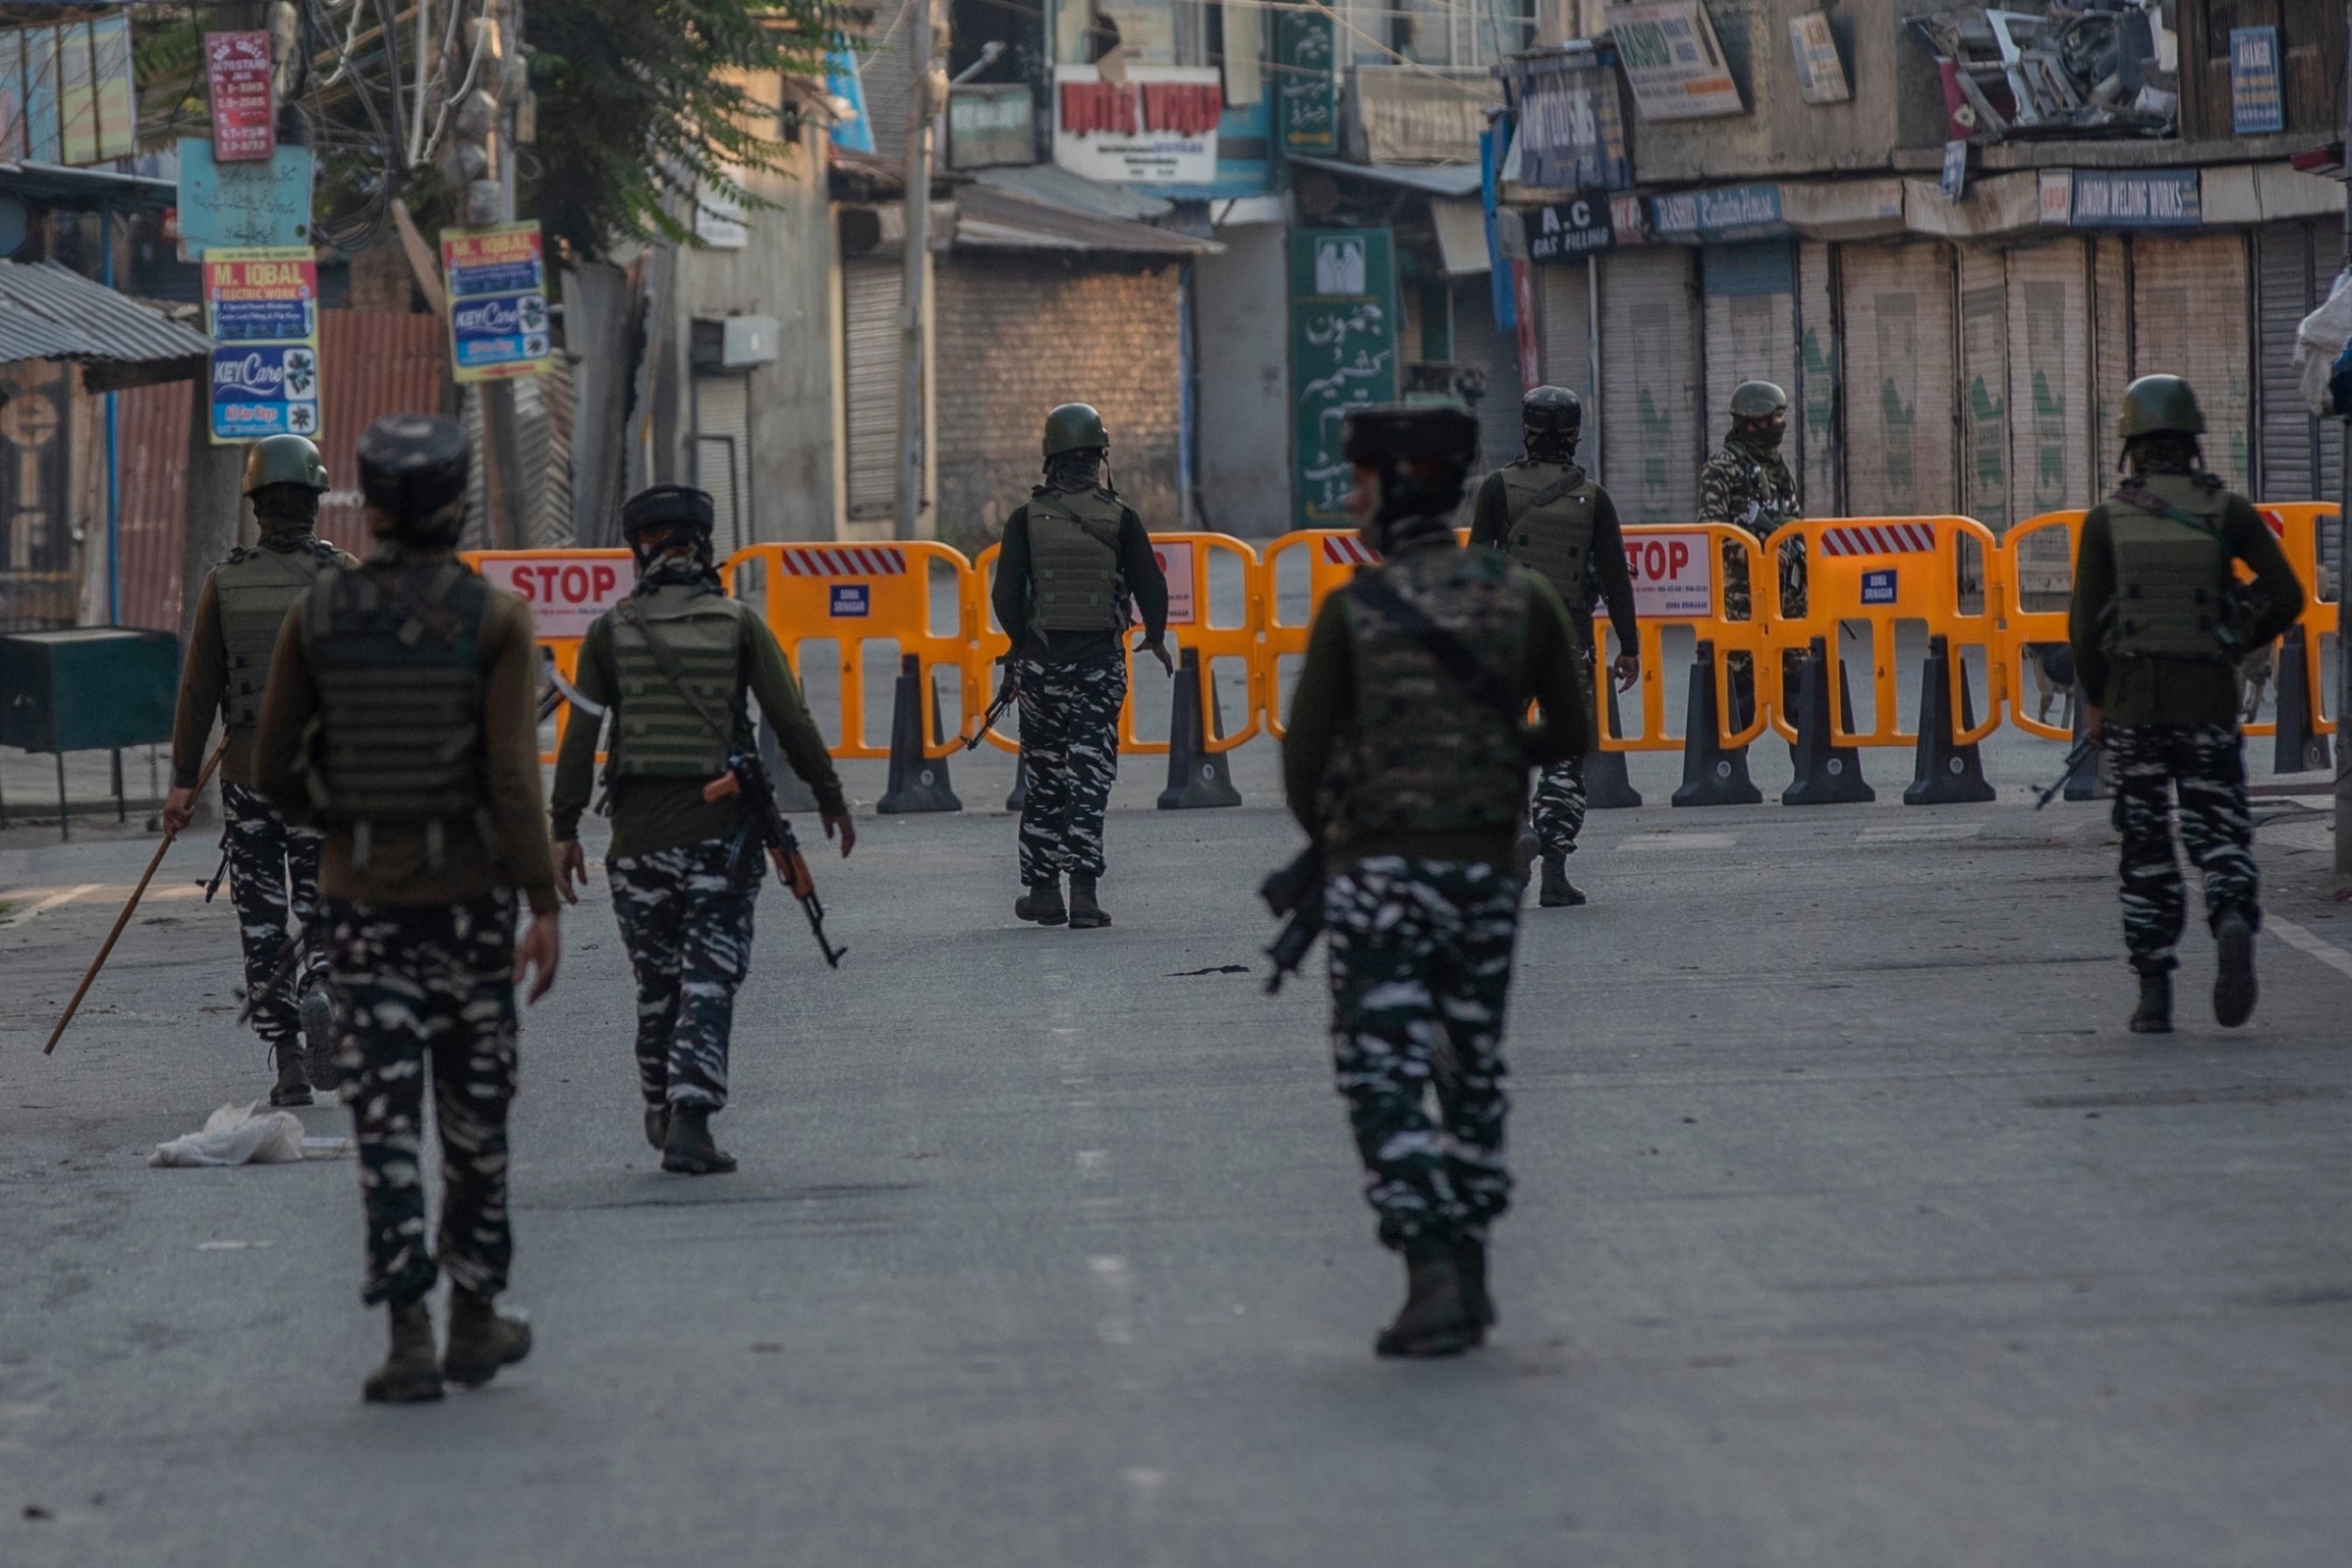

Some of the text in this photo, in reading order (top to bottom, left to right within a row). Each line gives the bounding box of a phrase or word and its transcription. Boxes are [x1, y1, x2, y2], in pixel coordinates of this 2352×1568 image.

[2111, 180, 2148, 218] WELDING
[2150, 180, 2183, 218] WORKS
[1542, 199, 1591, 235] A.C
[1564, 226, 1610, 252] FILLING
[214, 262, 305, 289] M. IQBAL
[222, 288, 297, 300] ELECTRIC WORK
[1298, 349, 1392, 403] کشمیر
[226, 405, 278, 423] All Car Keys
[1624, 540, 1690, 581] TOP
[511, 564, 616, 603] STOP
[1865, 588, 1893, 600] SRINAGAR
